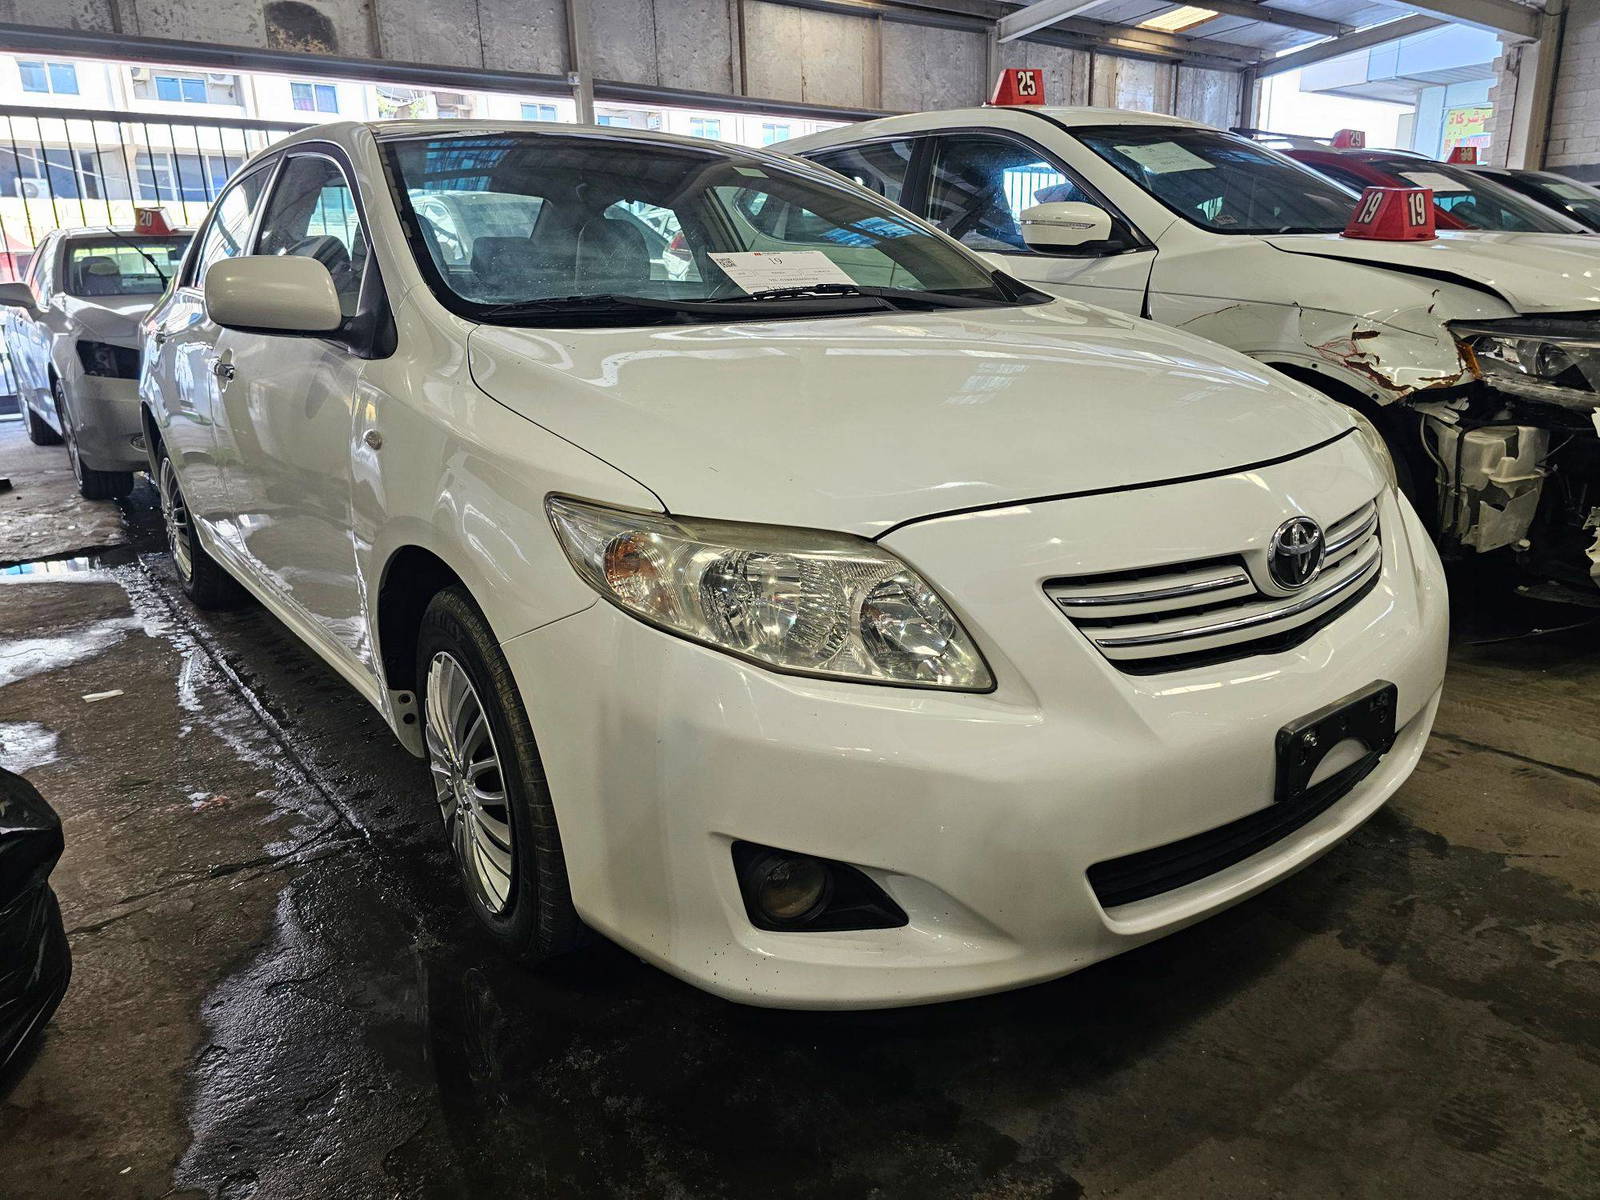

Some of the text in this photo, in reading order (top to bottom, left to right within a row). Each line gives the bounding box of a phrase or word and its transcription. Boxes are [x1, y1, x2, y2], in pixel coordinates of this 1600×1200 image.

[1017, 71, 1036, 96] 25
[1350, 131, 1361, 147] 29
[140, 210, 153, 227] 20
[1357, 191, 1384, 223] 19
[1408, 192, 1426, 226] 19
